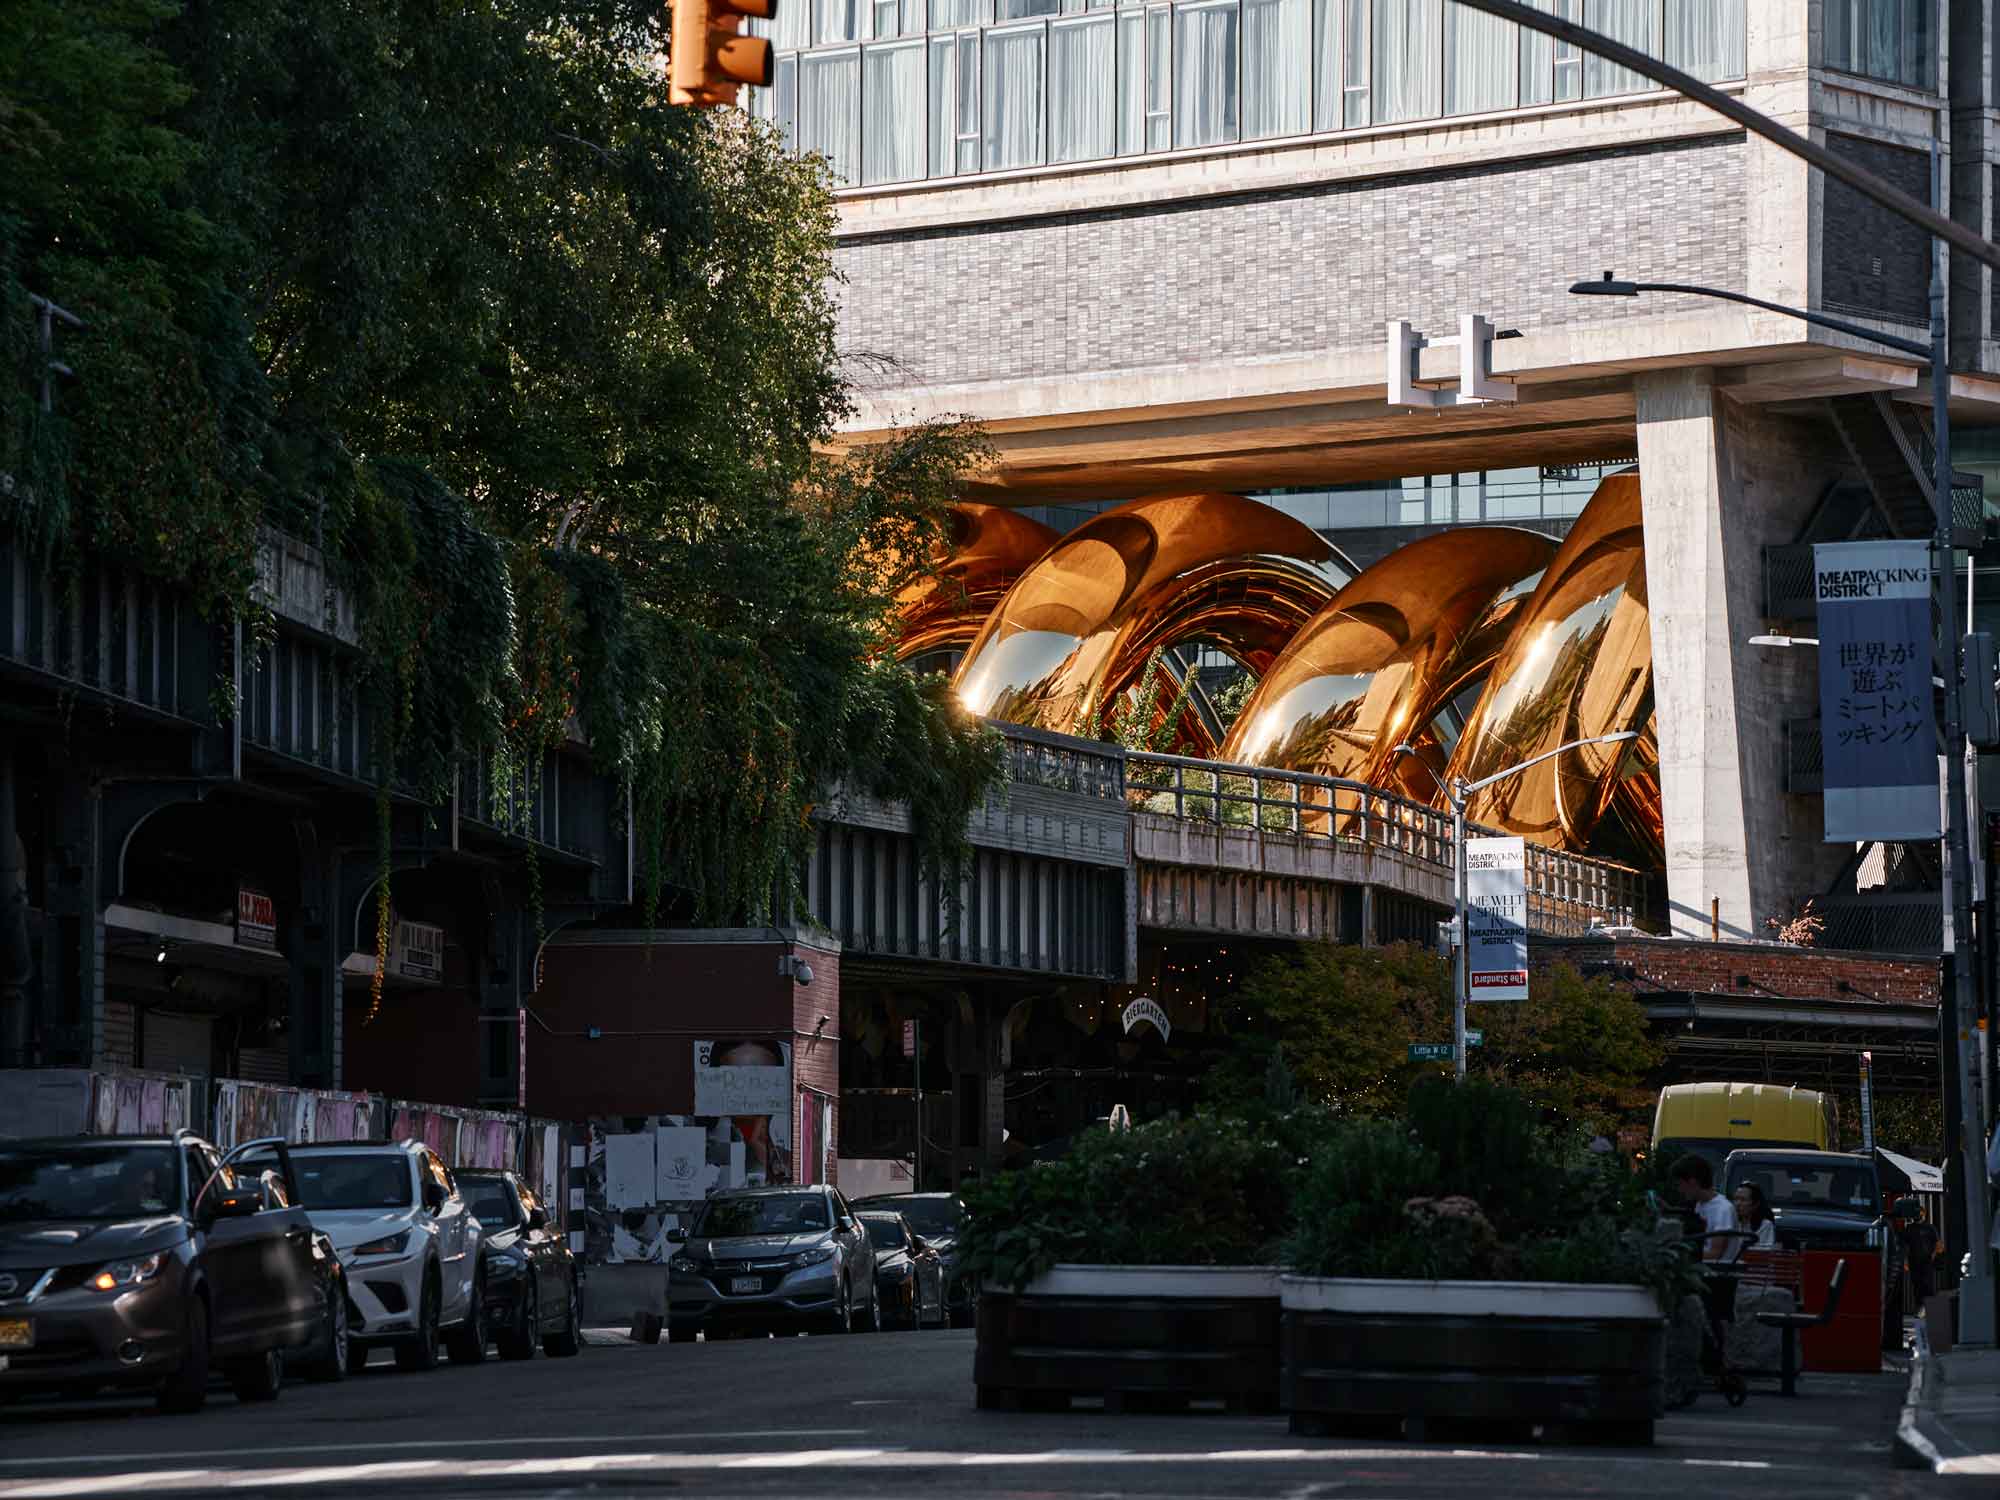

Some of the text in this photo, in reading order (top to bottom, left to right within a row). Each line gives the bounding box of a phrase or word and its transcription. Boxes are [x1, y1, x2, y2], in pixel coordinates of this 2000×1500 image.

[1818, 566, 1928, 585] MEATPACKING
[1819, 582, 1886, 599] DISTRICT
[1840, 641, 1916, 668] 世界が
[1852, 667, 1902, 694] 遊ぶ
[1838, 696, 1920, 720] ミートパ
[1837, 718, 1924, 746] ッキング
[1468, 851, 1523, 861] MEATPACKING
[1468, 860, 1500, 869] DISTRICT
[1490, 917, 1504, 928] IN
[1470, 928, 1525, 937] MEATPACKING
[1481, 937, 1514, 945] DISTRICT
[1474, 973, 1525, 985] The Standard
[1125, 1001, 1168, 1033] BIERGARTEN
